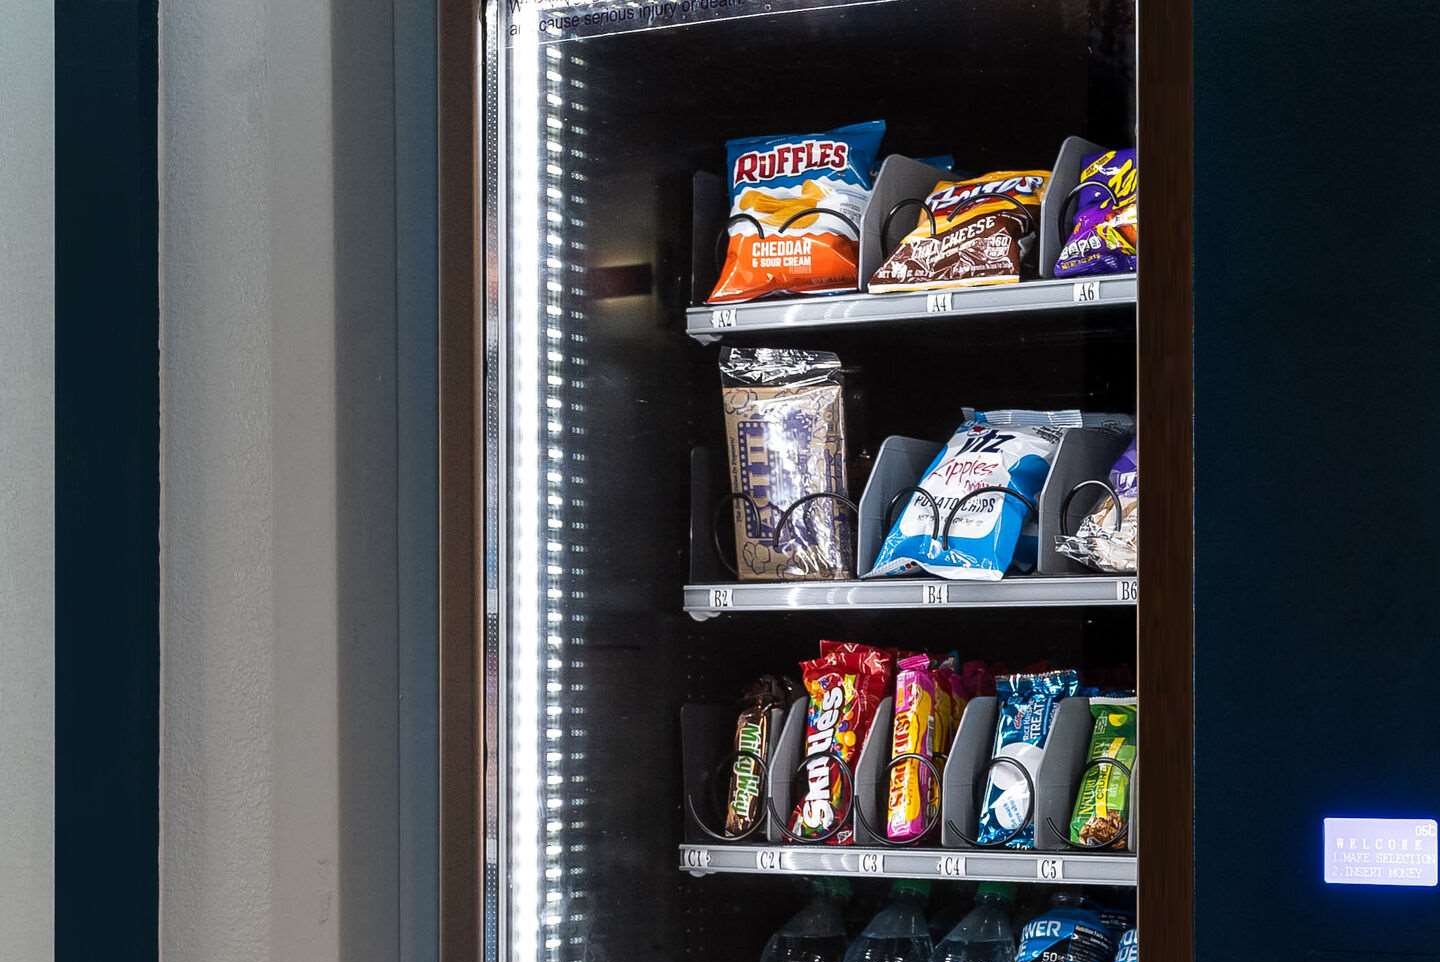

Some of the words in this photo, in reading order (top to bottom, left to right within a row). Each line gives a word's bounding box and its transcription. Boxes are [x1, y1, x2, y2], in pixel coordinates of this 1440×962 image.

[538, 17, 580, 33] cause
[584, 9, 634, 28] serious
[639, 1, 678, 25] injury
[682, 0, 697, 13] or
[735, 143, 849, 183] RUFFLES
[942, 215, 997, 249] CHEESE
[752, 240, 812, 257] CHEDDAR
[760, 256, 782, 267] SOUR
[783, 255, 812, 267] CREAM
[1079, 284, 1095, 301] A6
[932, 296, 947, 312] A4
[716, 310, 733, 327] A2
[961, 497, 996, 514] CHIPS
[714, 591, 728, 607] B2
[928, 585, 943, 603] B4
[1121, 582, 1137, 601] B6
[1030, 702, 1045, 739] TREAT
[688, 849, 702, 867] C1
[760, 851, 775, 868] C2
[863, 855, 878, 872] C3
[944, 857, 960, 875] C4
[1041, 860, 1057, 879] C5
